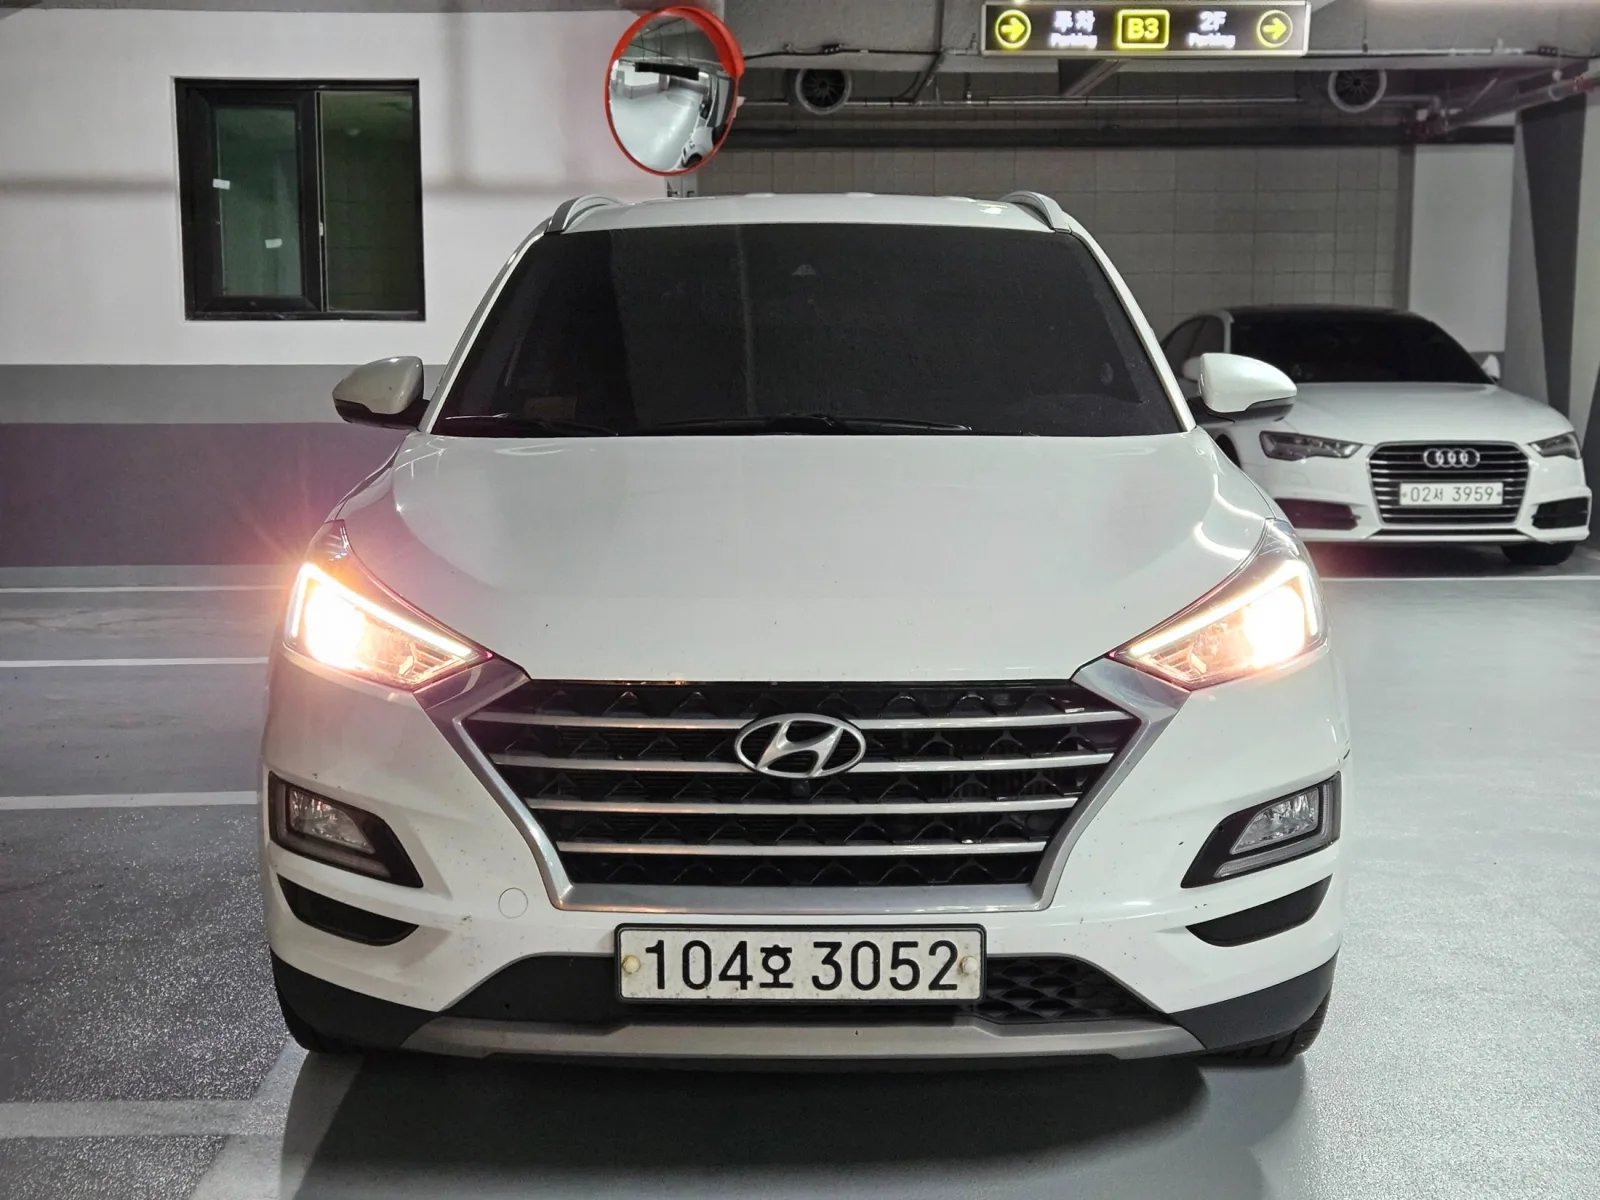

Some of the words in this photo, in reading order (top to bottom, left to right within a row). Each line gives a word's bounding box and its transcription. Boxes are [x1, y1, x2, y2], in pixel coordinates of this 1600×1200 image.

[1127, 17, 1160, 41] B3
[1199, 10, 1227, 32] 2F
[1410, 486, 1444, 502] 02서
[1452, 486, 1494, 502] 3959
[645, 939, 794, 990] 104호
[811, 940, 959, 991] 3052
